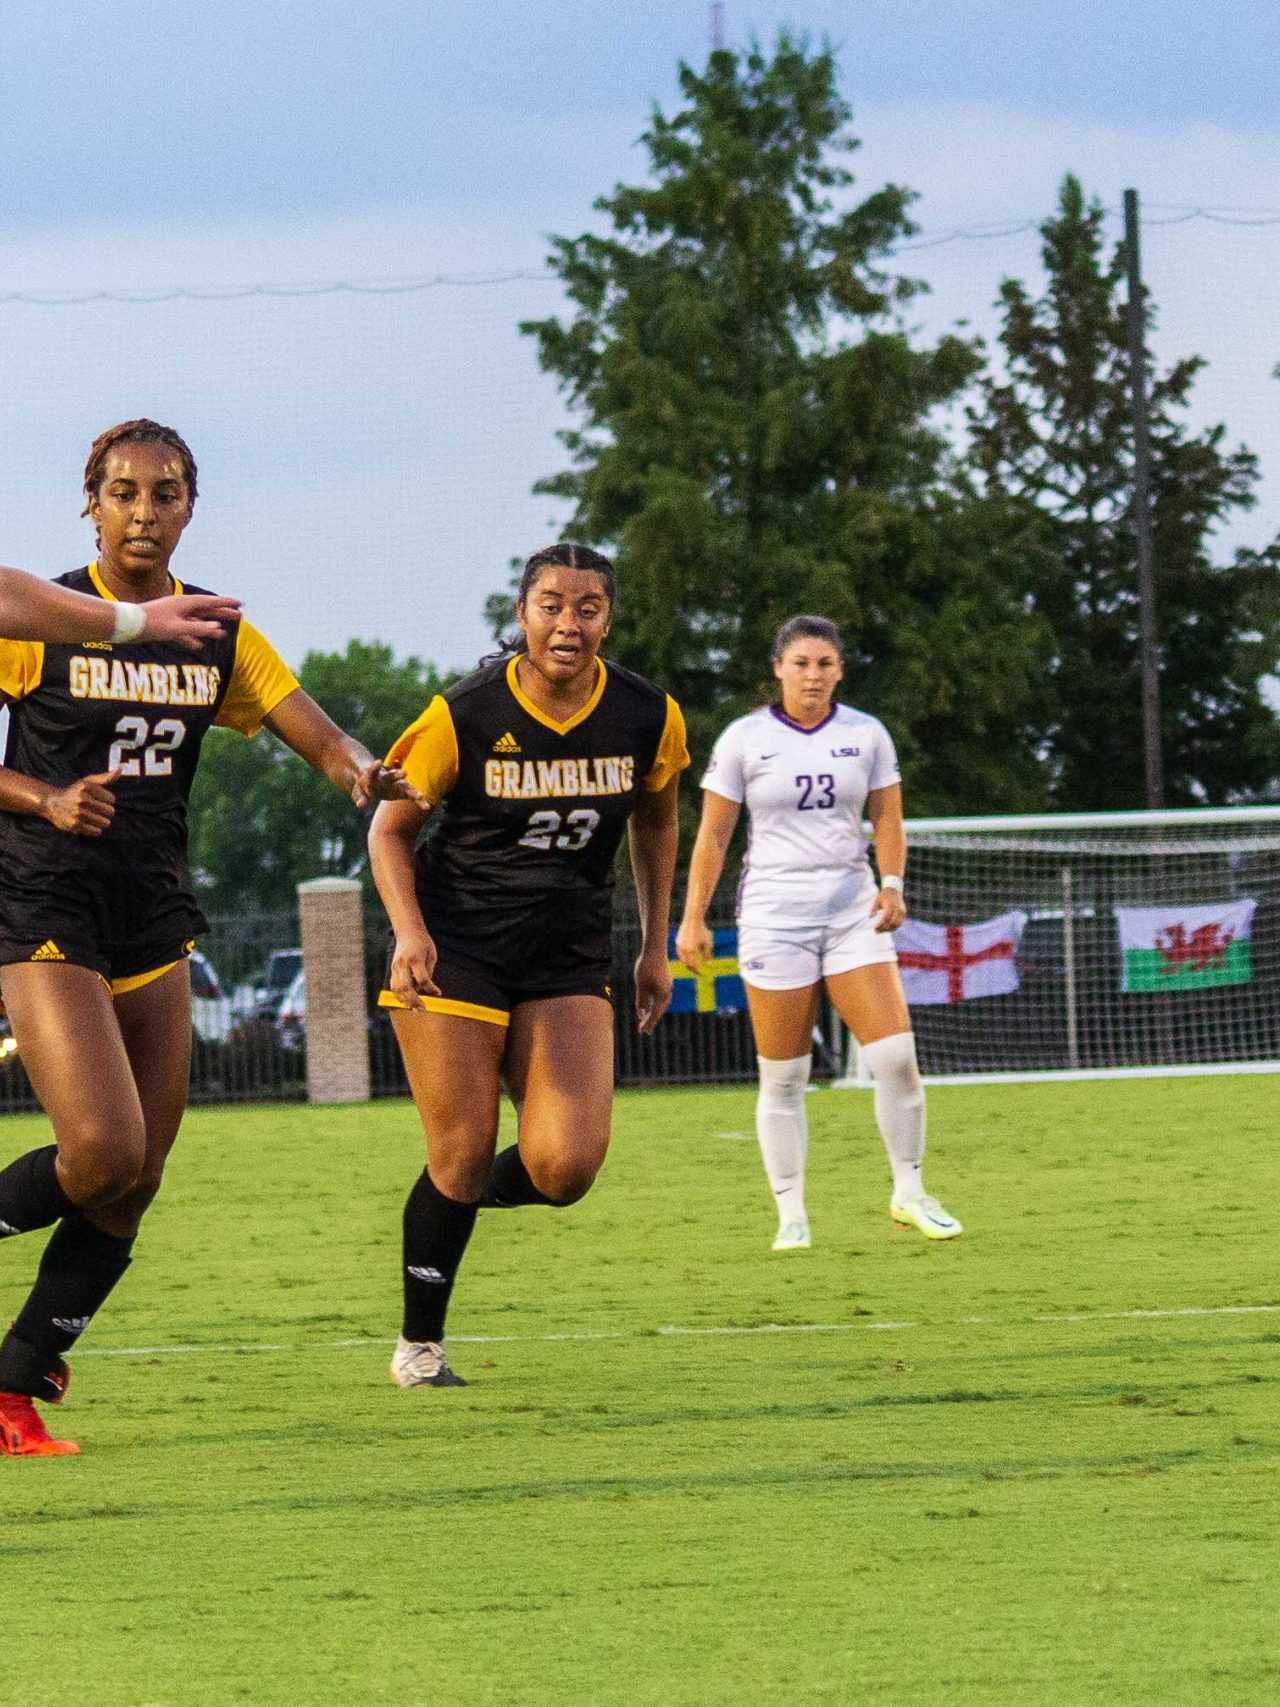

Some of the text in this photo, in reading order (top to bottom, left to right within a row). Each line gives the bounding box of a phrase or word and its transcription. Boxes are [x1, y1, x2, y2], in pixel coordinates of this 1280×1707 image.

[108, 715, 186, 777] 22
[830, 747, 860, 758] LSU
[484, 755, 635, 799] GRAMBLING
[795, 774, 836, 811] 23
[518, 809, 600, 850] 23
